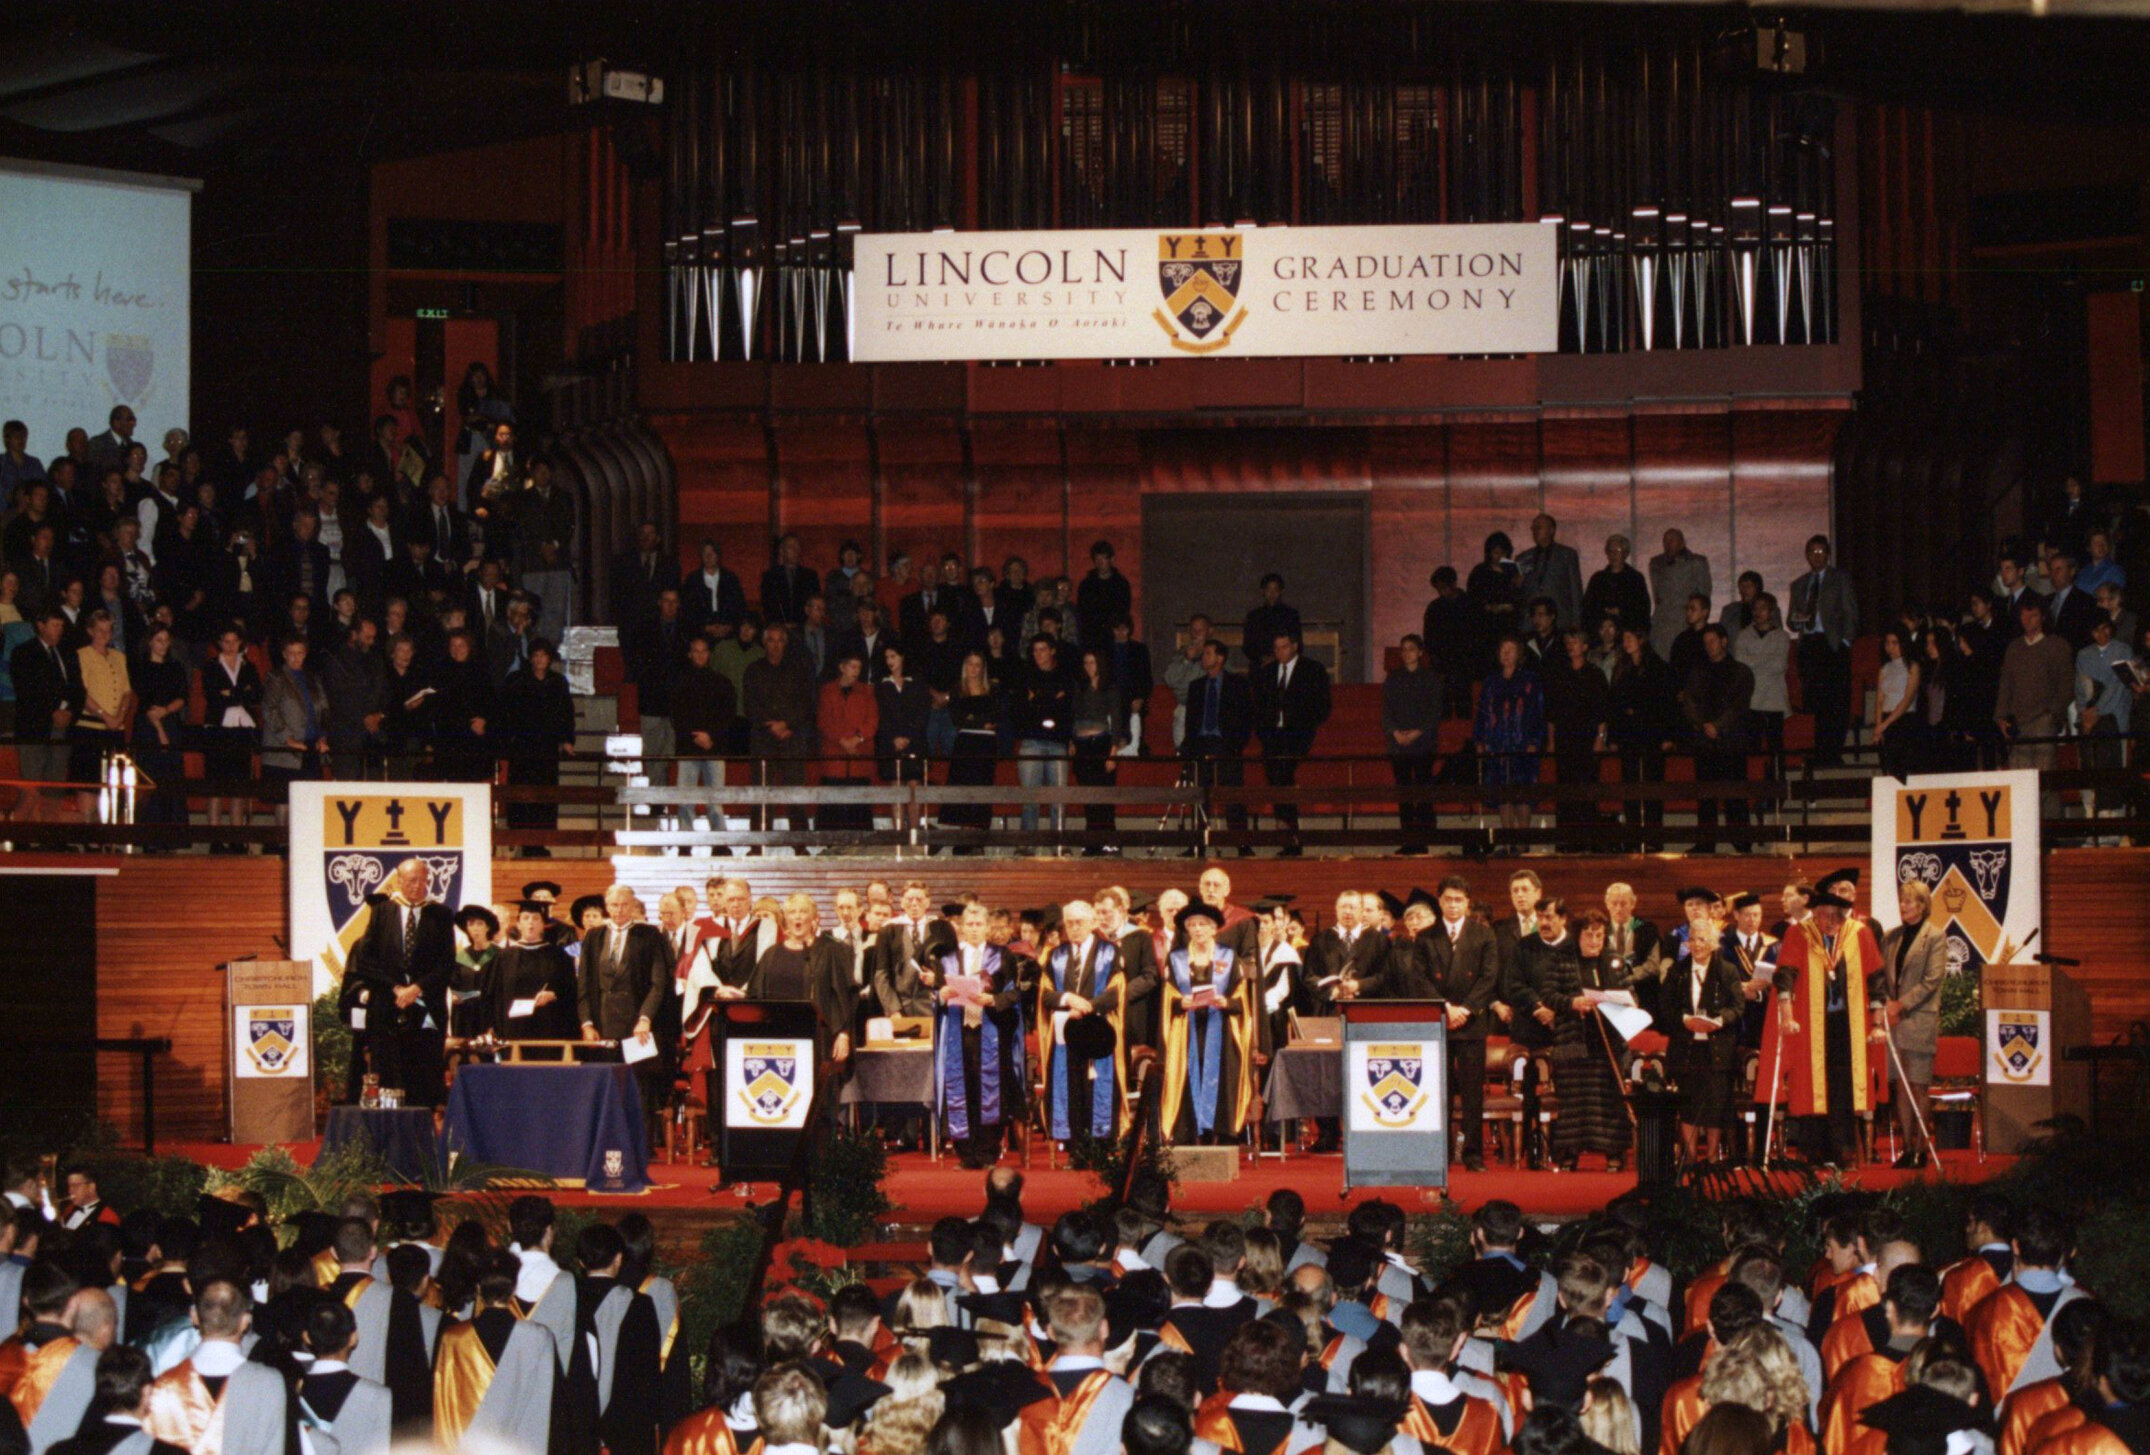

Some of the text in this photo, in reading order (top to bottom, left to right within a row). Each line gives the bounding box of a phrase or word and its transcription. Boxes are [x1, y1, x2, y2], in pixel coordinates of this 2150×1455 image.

[886, 249, 1128, 287] LINCOLN
[1273, 252, 1523, 281] GRADUATION
[1, 266, 81, 303] starts
[886, 291, 1127, 308] UNIVERSITY
[1272, 288, 1516, 312] CEREMONY
[416, 308, 448, 318] EXIT
[886, 320, 902, 331] Te
